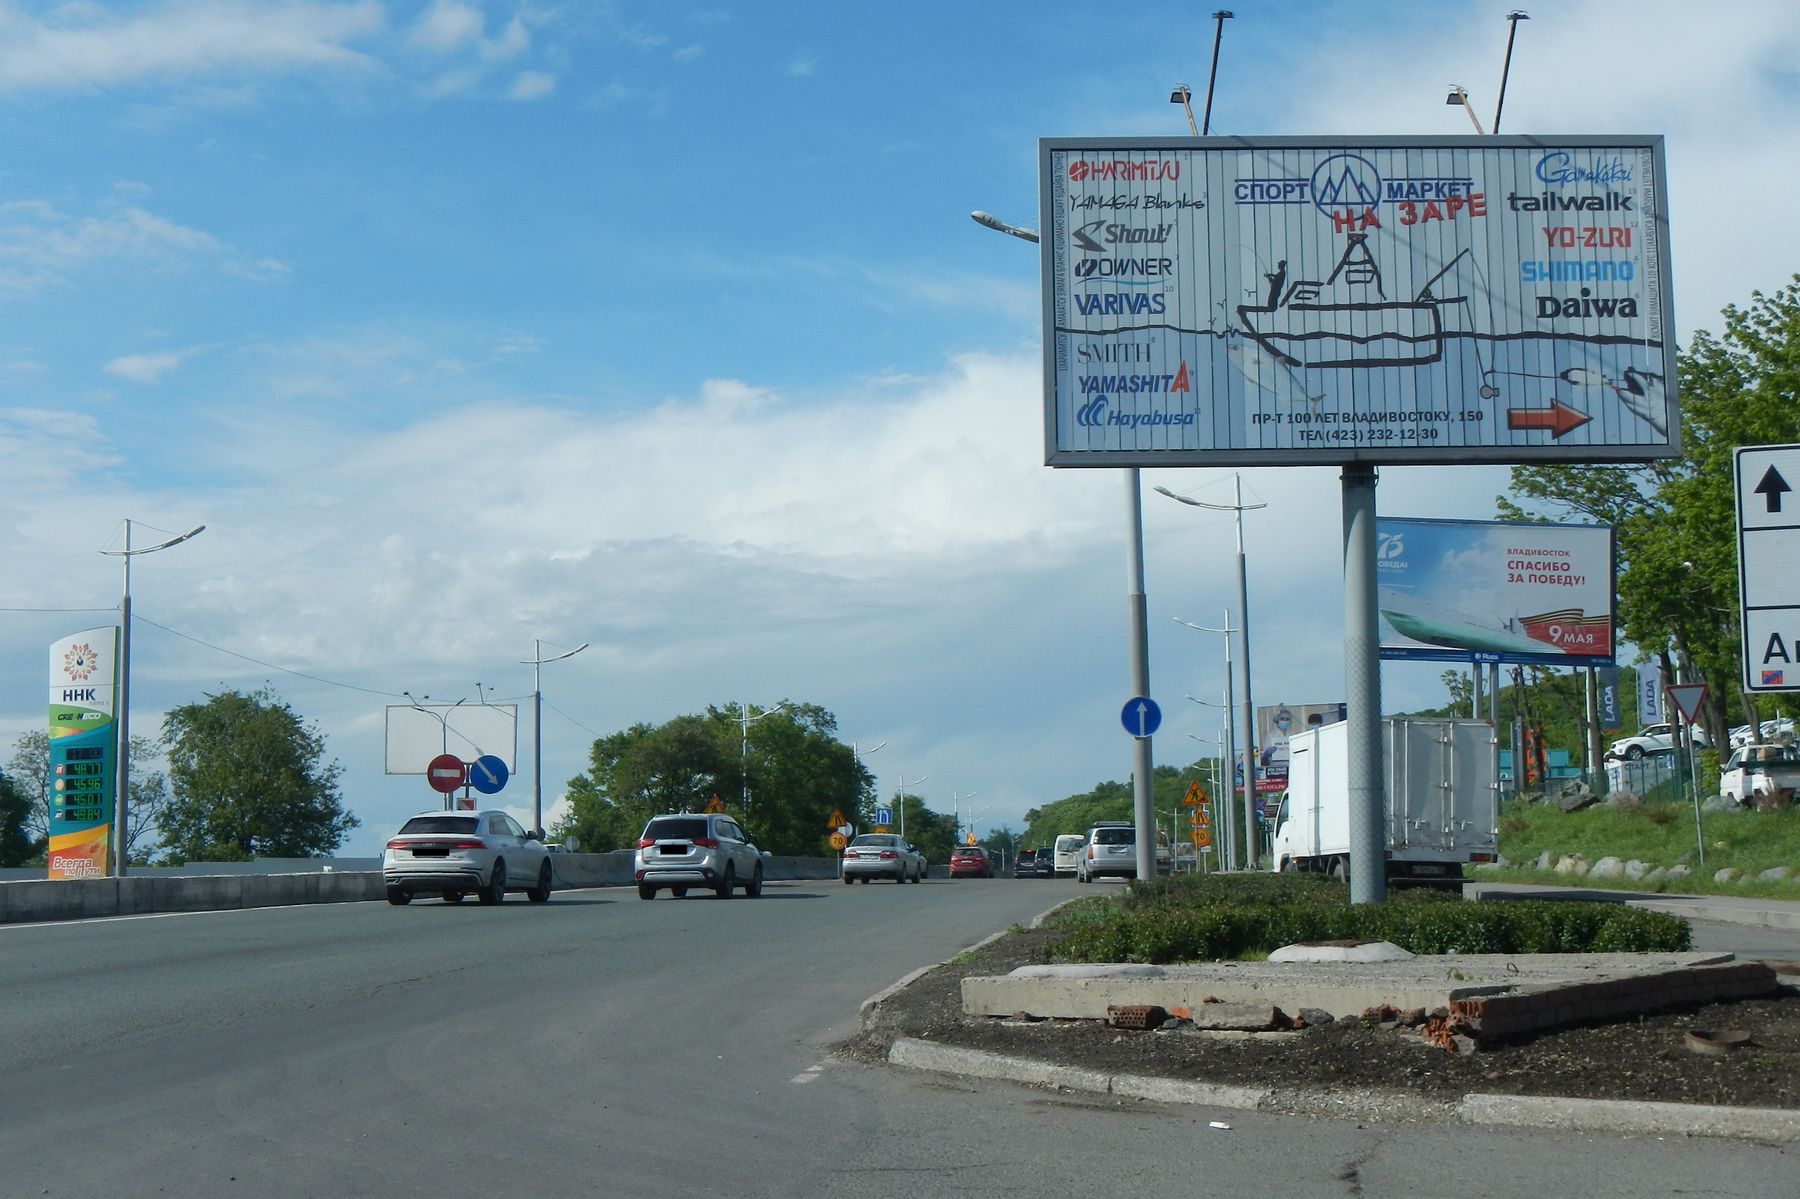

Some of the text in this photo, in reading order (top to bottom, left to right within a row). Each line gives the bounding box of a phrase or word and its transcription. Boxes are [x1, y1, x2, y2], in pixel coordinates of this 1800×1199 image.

[1234, 182, 1308, 200] СПОРТ
[1387, 182, 1474, 200] МАРКЕТ
[1069, 194, 1139, 212] YAMAGA
[1142, 193, 1206, 210] Blanks
[1507, 192, 1633, 212] tailwalk
[1333, 193, 1487, 234] НА ЗАРЕ
[1104, 224, 1173, 244] Shout!
[1543, 227, 1632, 248] YO-ZURI
[1099, 258, 1173, 277] OWNER
[1521, 260, 1634, 282] SHIMANO
[1074, 293, 1167, 315] VARIVAS
[1535, 287, 1638, 318] Daiwa
[1077, 343, 1152, 363] SMITH
[1078, 360, 1190, 394] YAMASHITA
[1107, 410, 1195, 429] Hayabusa
[1252, 410, 1484, 425] ПР-Т 100 ЛЕТ ВЛАДИВОСТОКУ, 150
[1367, 428, 1439, 441] 232-12-30
[1507, 548, 1570, 557] ВЛАДИВОСТОК
[1507, 560, 1571, 572] СПАСИБО
[1507, 573, 1585, 586] ЗА ПОБЕДУ!
[1549, 625, 1593, 644] 9 МАЯ
[63, 688, 96, 701] ННК
[1604, 685, 1615, 722] LADA
[1645, 680, 1657, 717] LADA
[834, 837, 843, 845] 70
